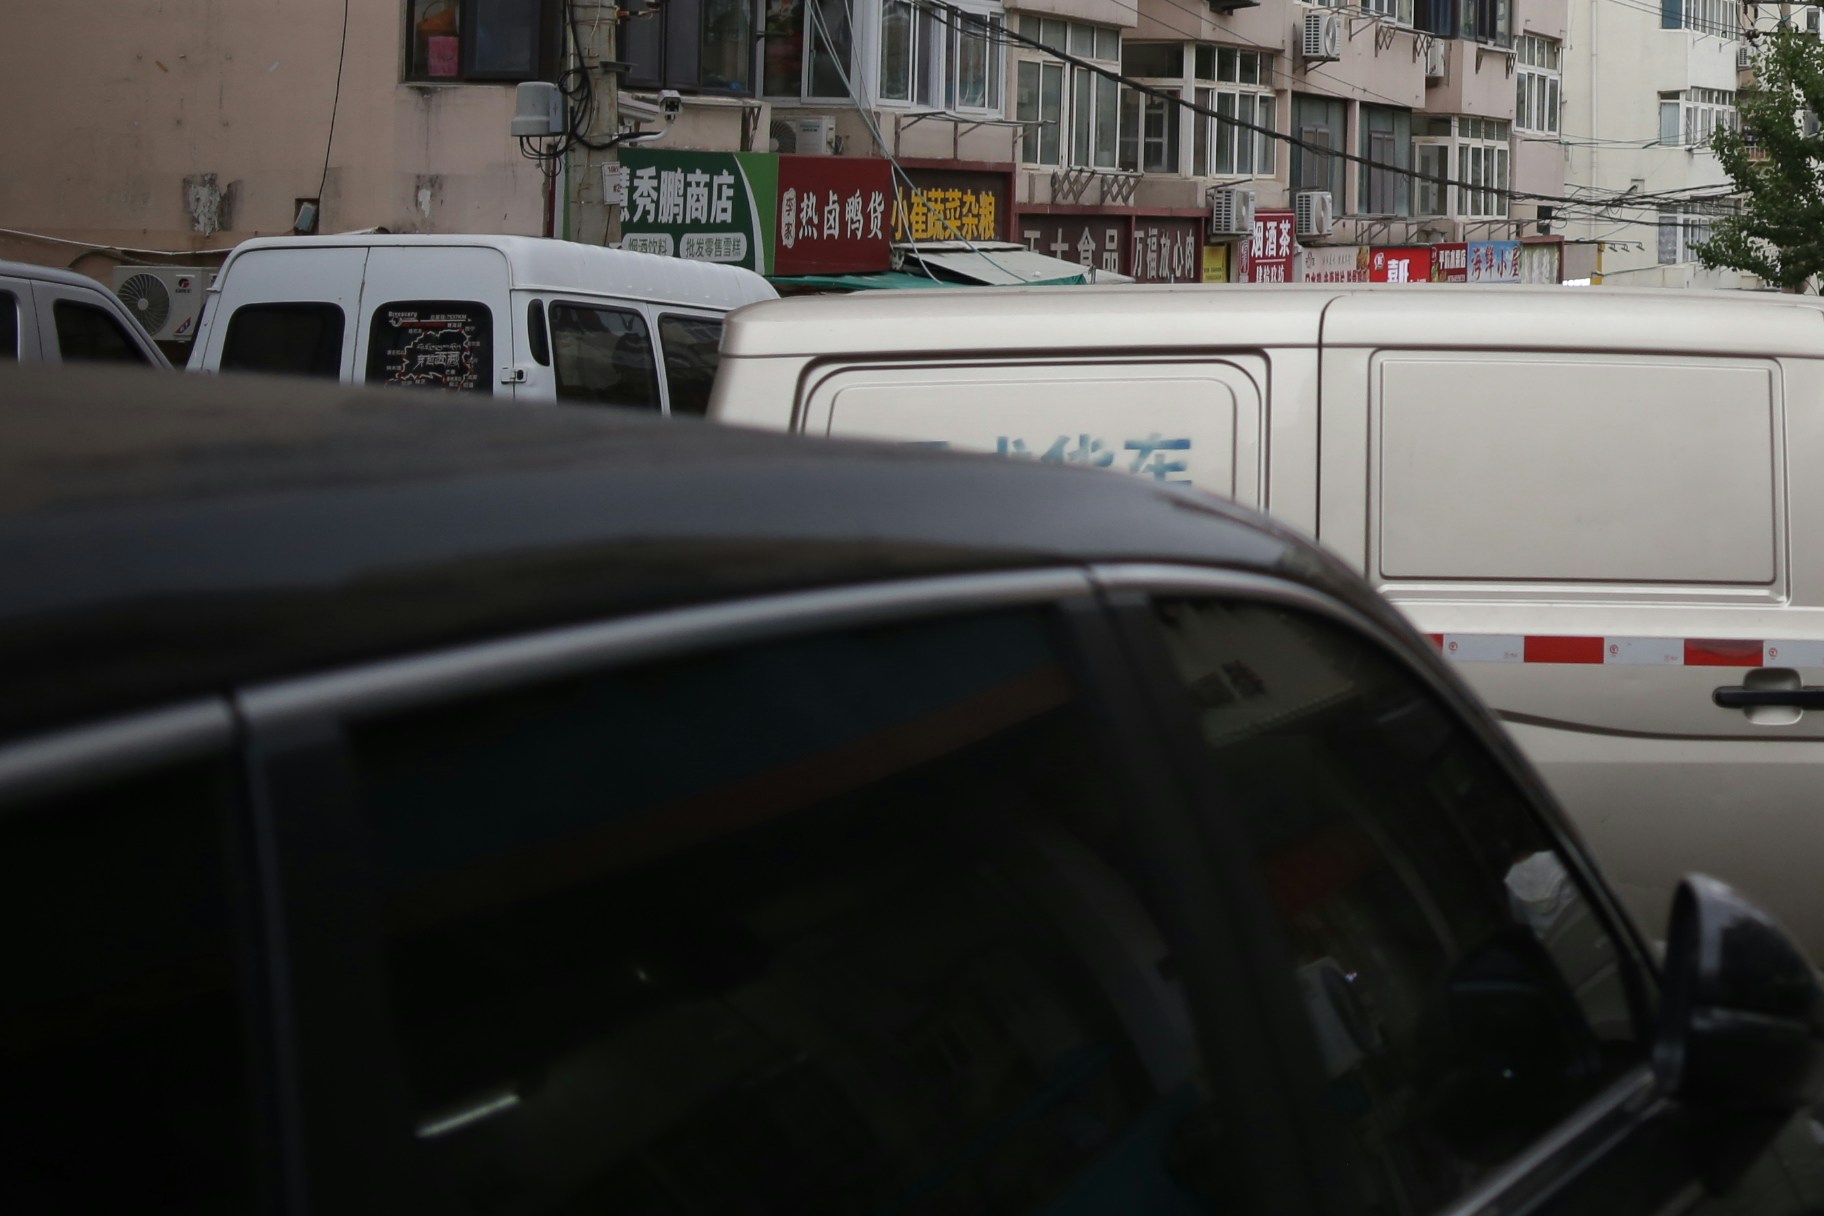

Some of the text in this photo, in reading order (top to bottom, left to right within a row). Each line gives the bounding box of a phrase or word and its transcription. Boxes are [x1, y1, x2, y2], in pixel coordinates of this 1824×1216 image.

[799, 188, 885, 241] 热卤鸭货
[890, 186, 995, 241] 小崔蔬菜杂粮
[1251, 219, 1291, 259] 烟酒茶
[686, 237, 741, 258] 批发零售雪糕
[1133, 227, 1195, 280] 万福放心肉
